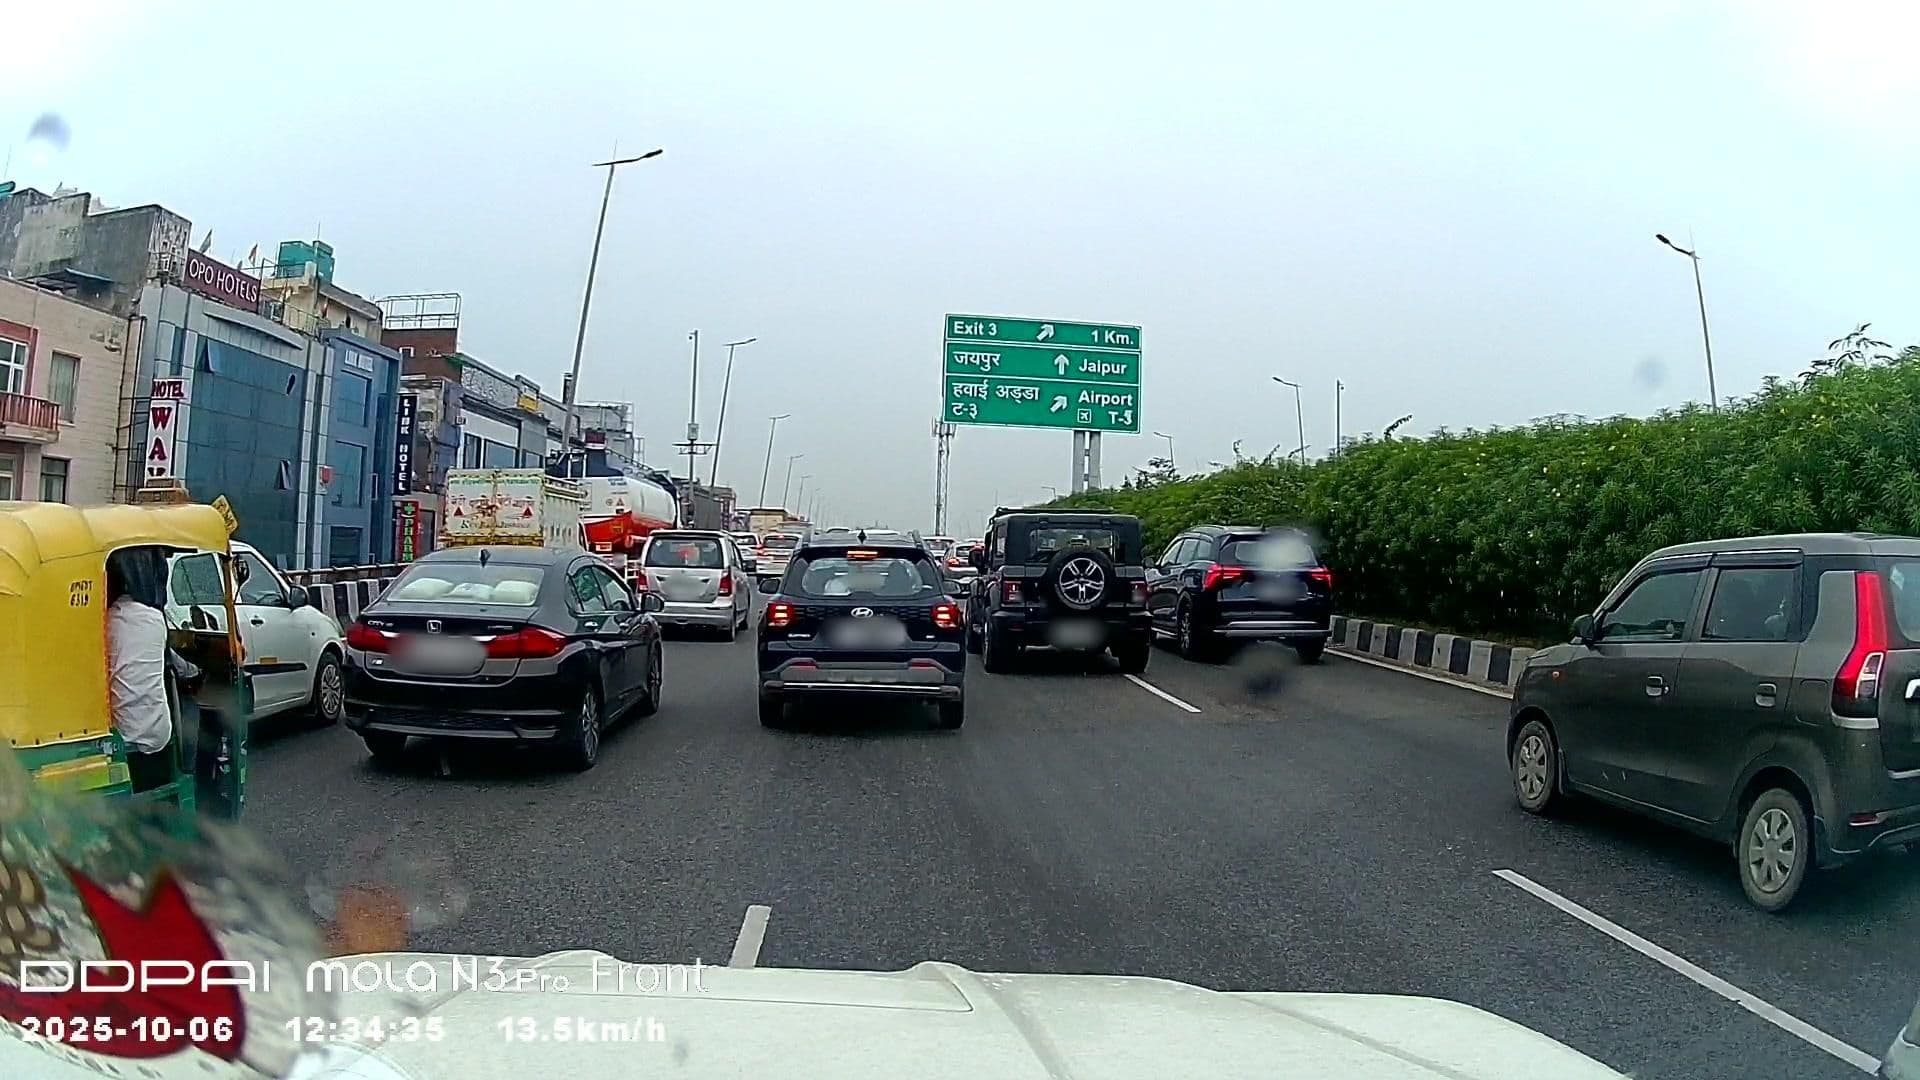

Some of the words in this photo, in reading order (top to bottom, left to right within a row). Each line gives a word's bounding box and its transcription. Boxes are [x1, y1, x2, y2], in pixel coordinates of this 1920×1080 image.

[189, 258, 214, 284] OPO
[216, 269, 258, 303] HOTELS
[953, 320, 984, 336] Exit
[988, 322, 998, 336] 3
[1091, 330, 1099, 342] 1
[1104, 330, 1134, 345] Km.
[952, 351, 1001, 372] जयपुर
[1078, 358, 1127, 377] Jaipur
[151, 380, 184, 397] HOTEL
[952, 379, 988, 400] हवाई
[1078, 389, 1133, 407] Airport
[398, 444, 409, 491] HOTEL
